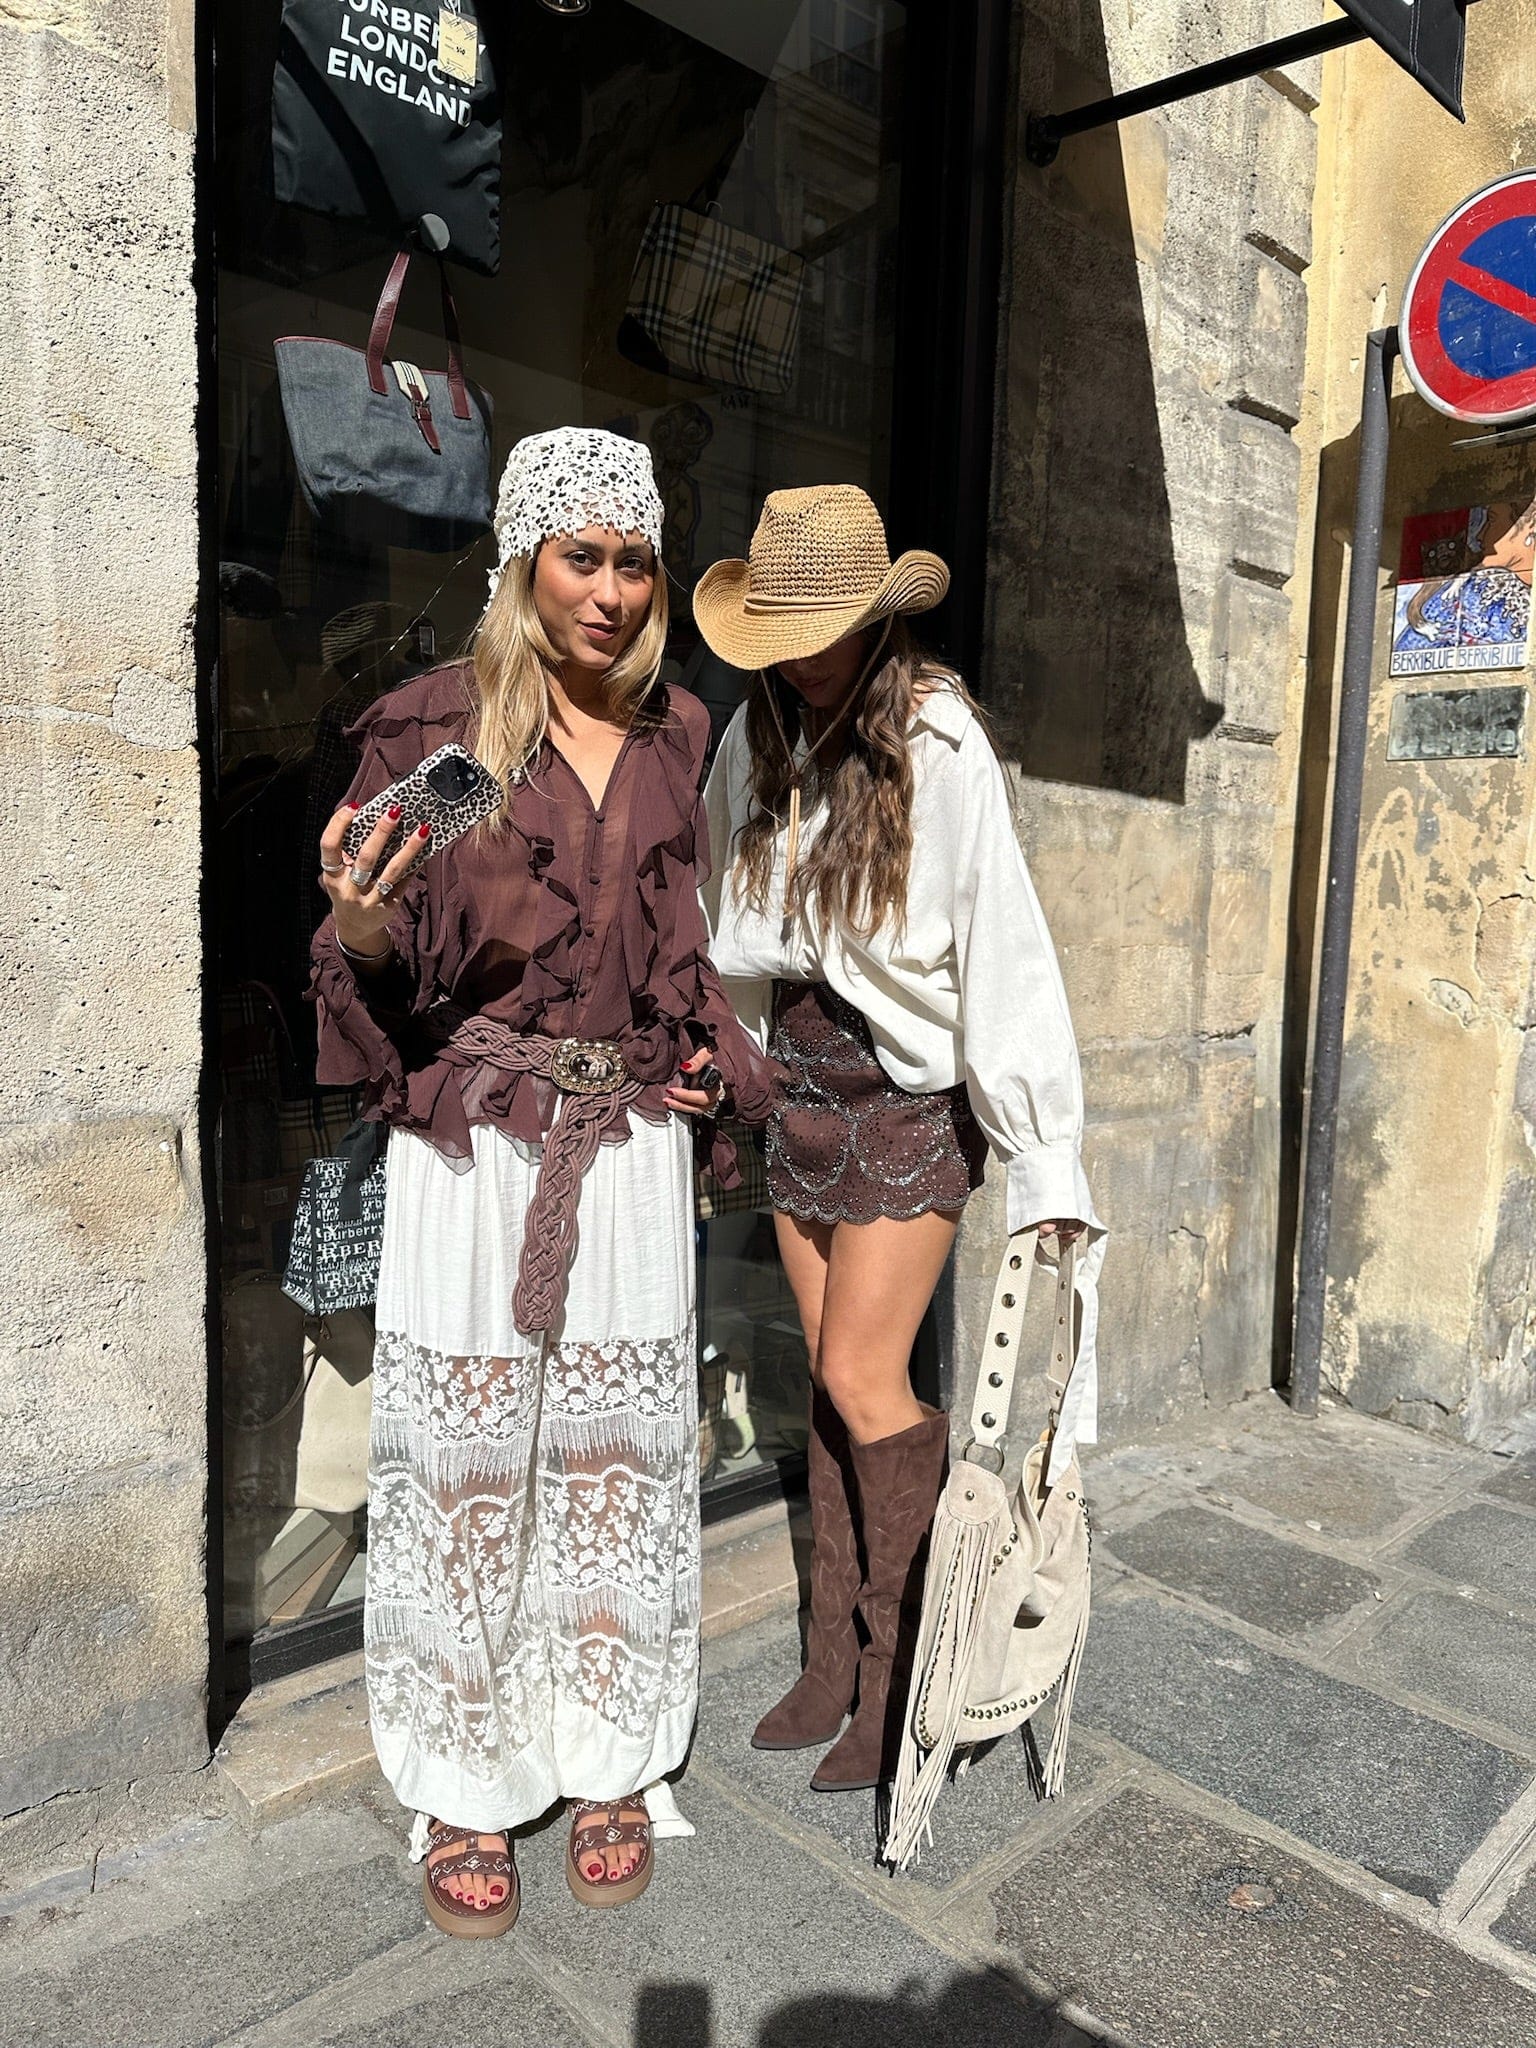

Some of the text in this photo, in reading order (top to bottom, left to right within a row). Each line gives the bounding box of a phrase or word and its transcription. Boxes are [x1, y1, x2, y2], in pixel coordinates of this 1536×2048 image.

[339, 0, 486, 55] URBE
[340, 14, 470, 94] LONDO
[327, 47, 472, 128] ENGLAND
[323, 1224, 385, 1242] Burberry
